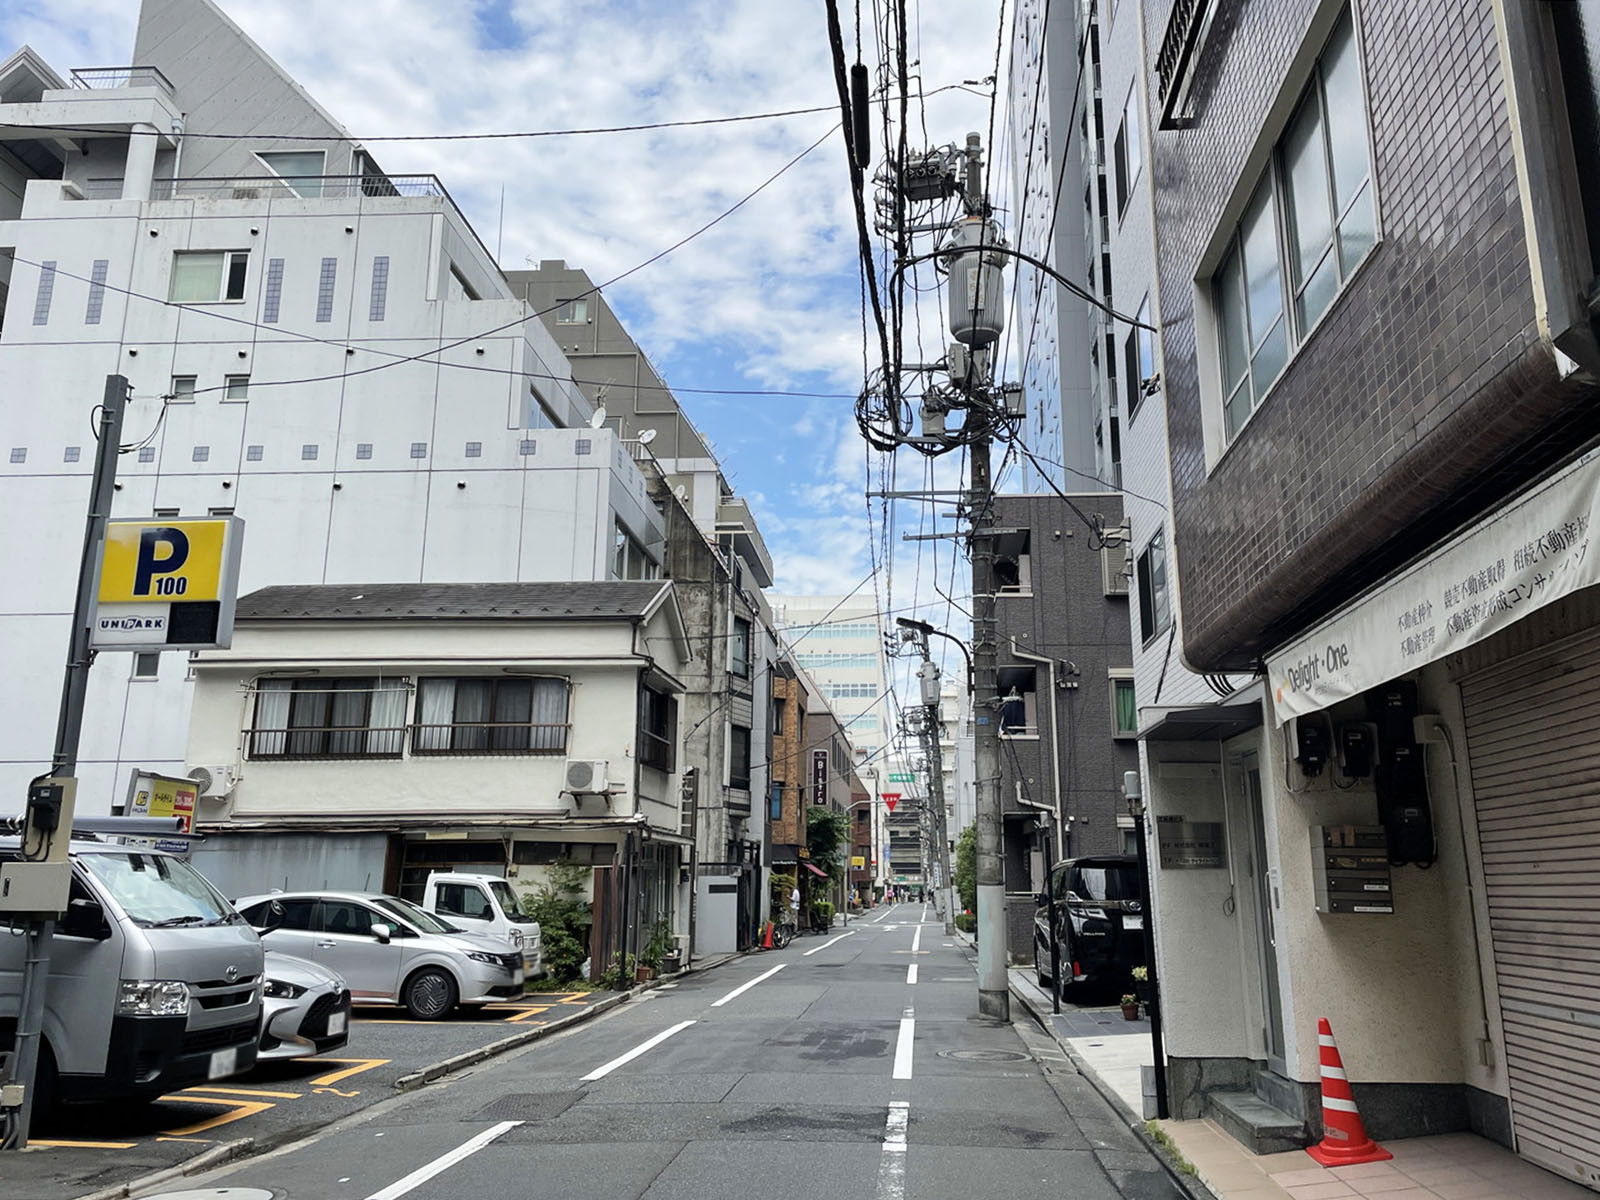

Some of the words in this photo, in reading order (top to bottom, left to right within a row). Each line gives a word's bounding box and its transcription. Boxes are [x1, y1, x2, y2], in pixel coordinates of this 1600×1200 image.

[133, 527, 190, 596] P
[155, 576, 188, 596] 100
[101, 618, 163, 630] UNIPARK
